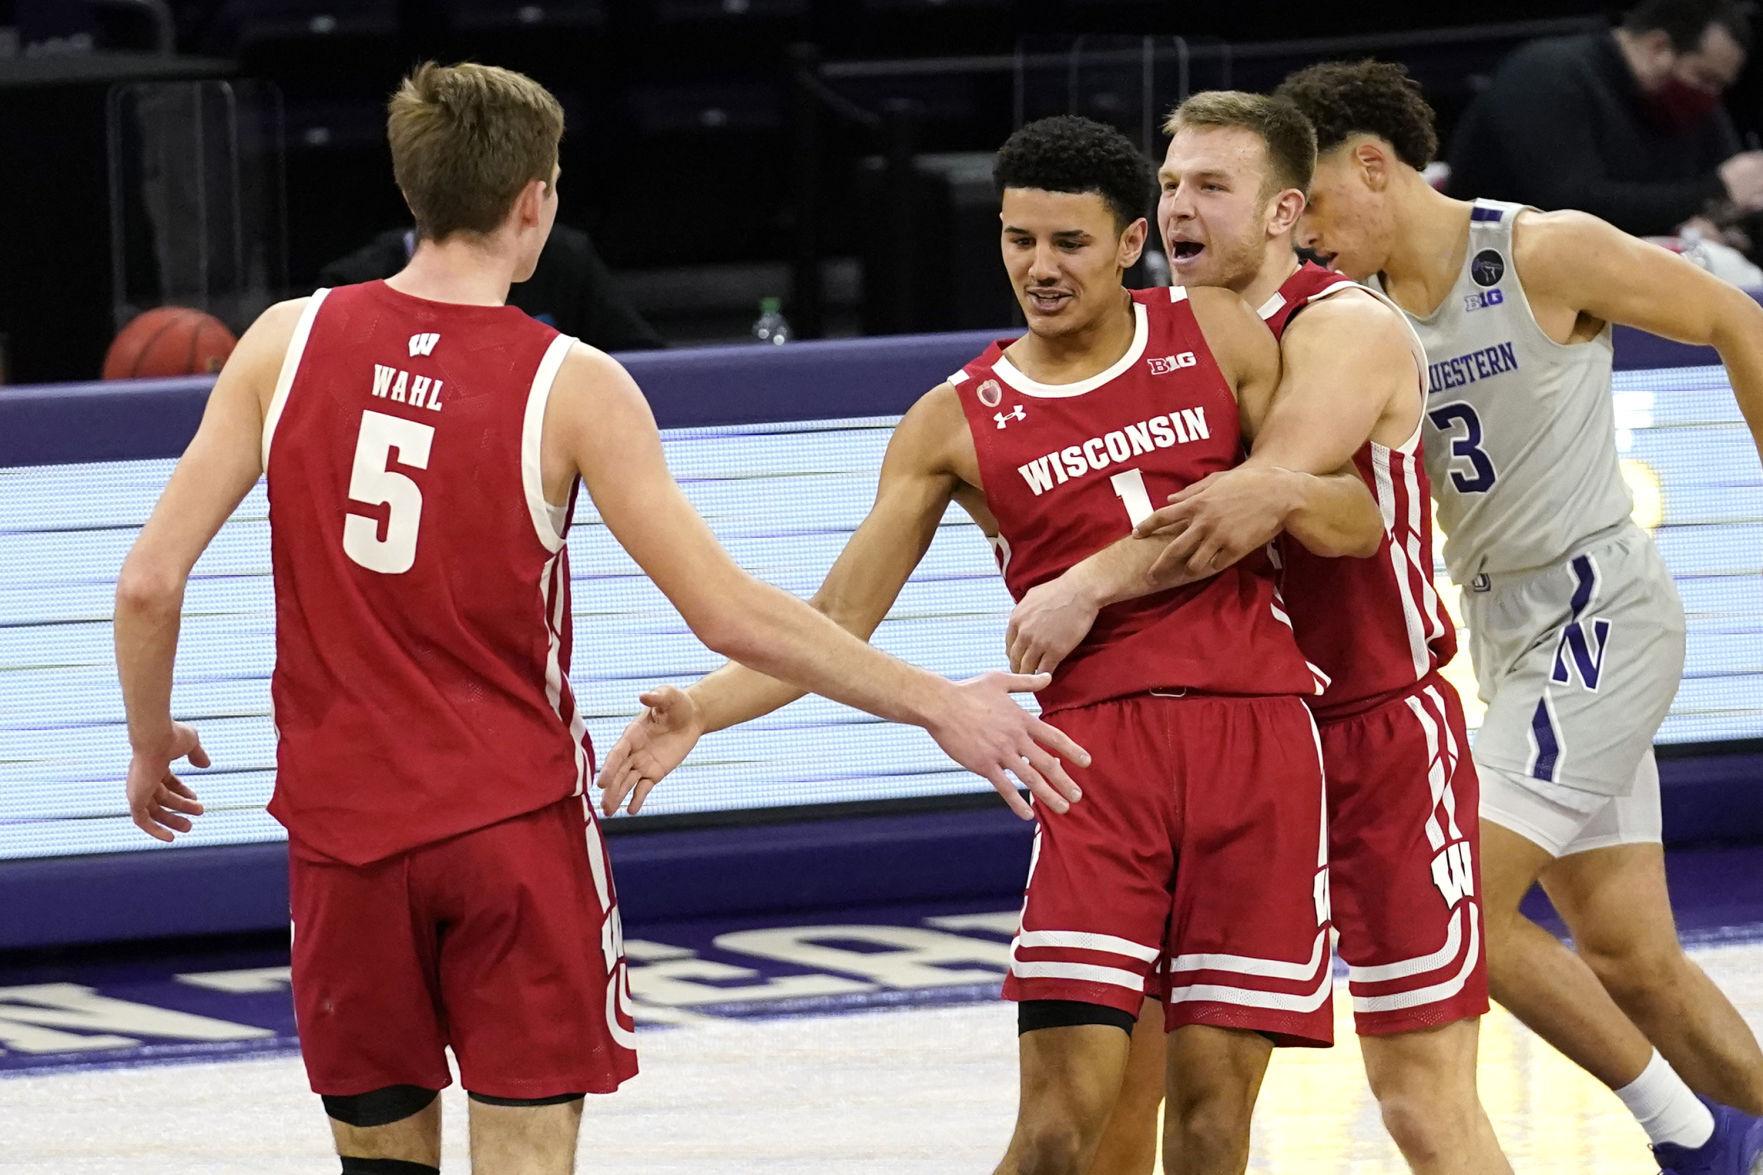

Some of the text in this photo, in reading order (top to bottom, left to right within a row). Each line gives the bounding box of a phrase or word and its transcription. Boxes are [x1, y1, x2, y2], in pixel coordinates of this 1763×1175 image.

[408, 333, 440, 357] W
[1429, 341, 1518, 394] WESTERN
[372, 364, 443, 411] WAHL
[1017, 406, 1210, 496] WISCONSIN
[1427, 400, 1497, 494] 3
[343, 409, 435, 574] 5
[1110, 468, 1155, 533] 1
[1550, 618, 1612, 691] N
